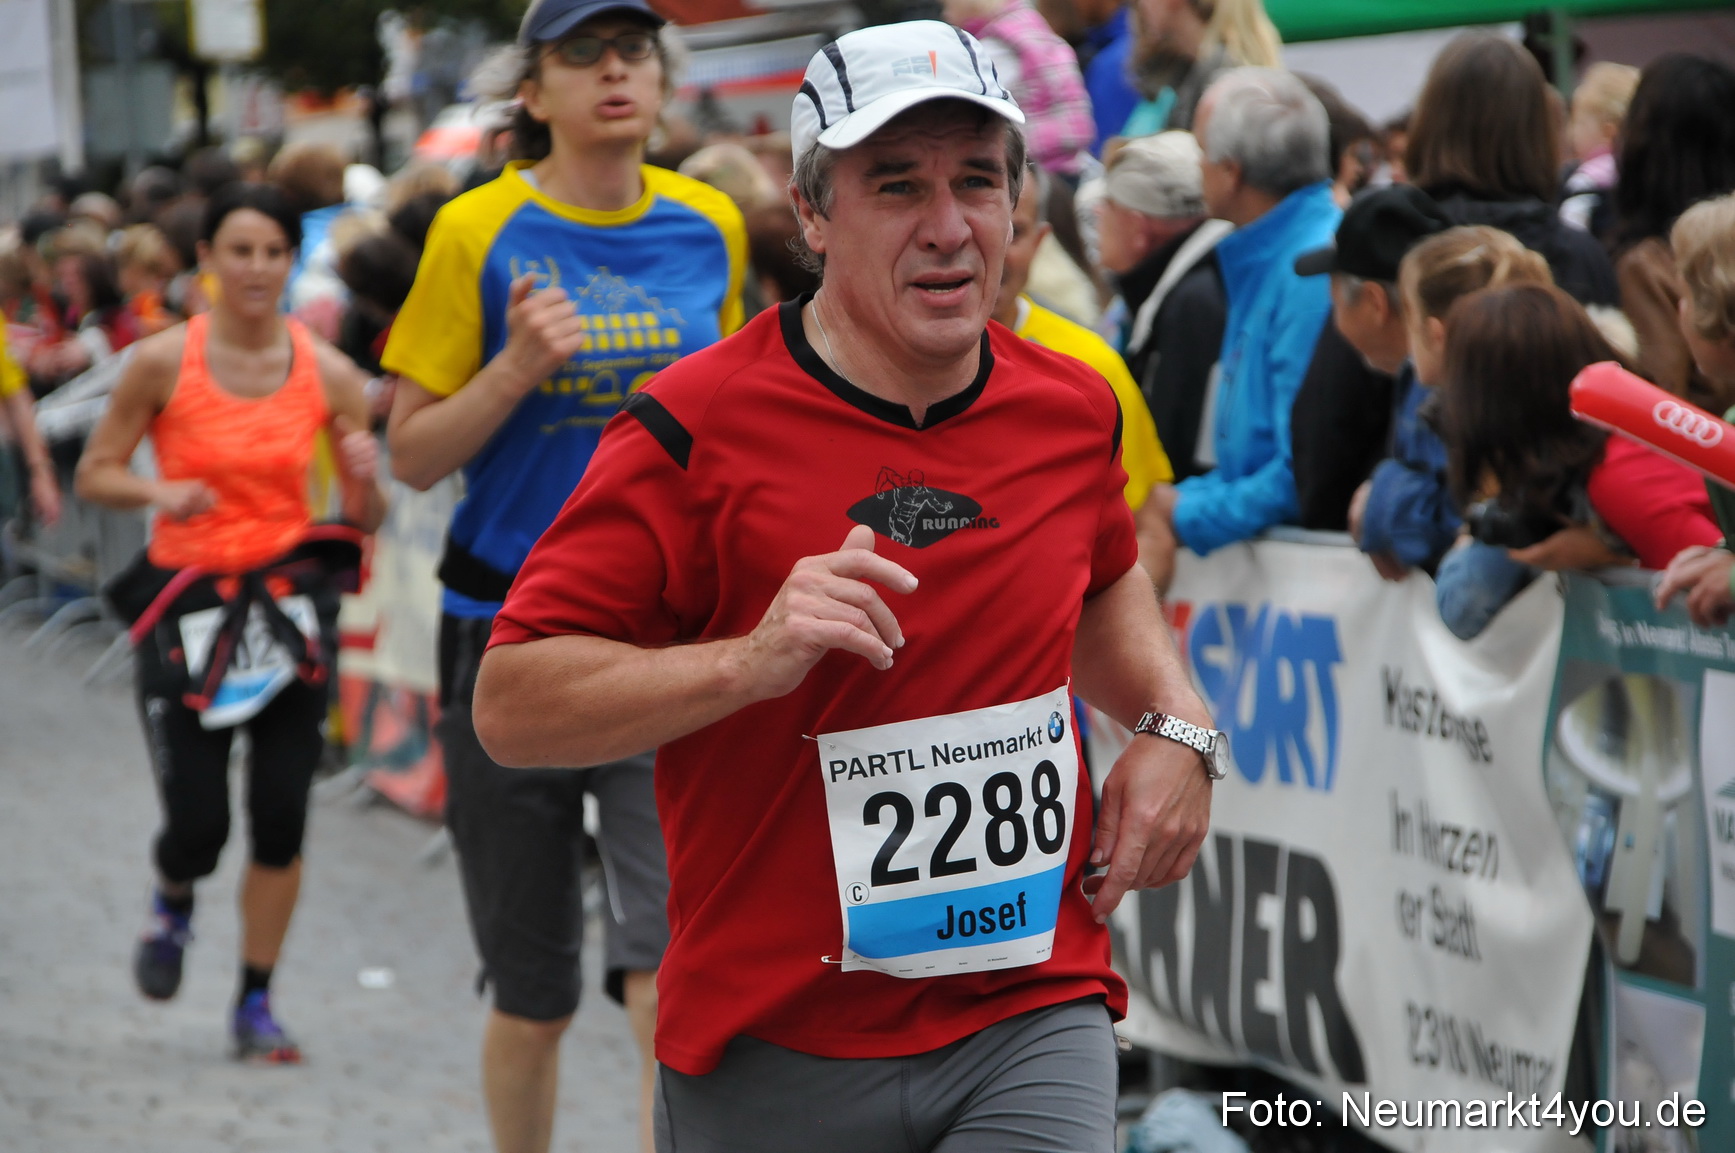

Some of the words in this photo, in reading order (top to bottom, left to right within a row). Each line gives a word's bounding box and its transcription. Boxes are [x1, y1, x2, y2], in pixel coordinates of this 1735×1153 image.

[828, 747, 926, 783] PARTL
[930, 725, 1043, 767] Neumarkt
[862, 759, 1066, 888] 2288
[936, 891, 1028, 941] Josef
[1110, 832, 1369, 1086] RNER
